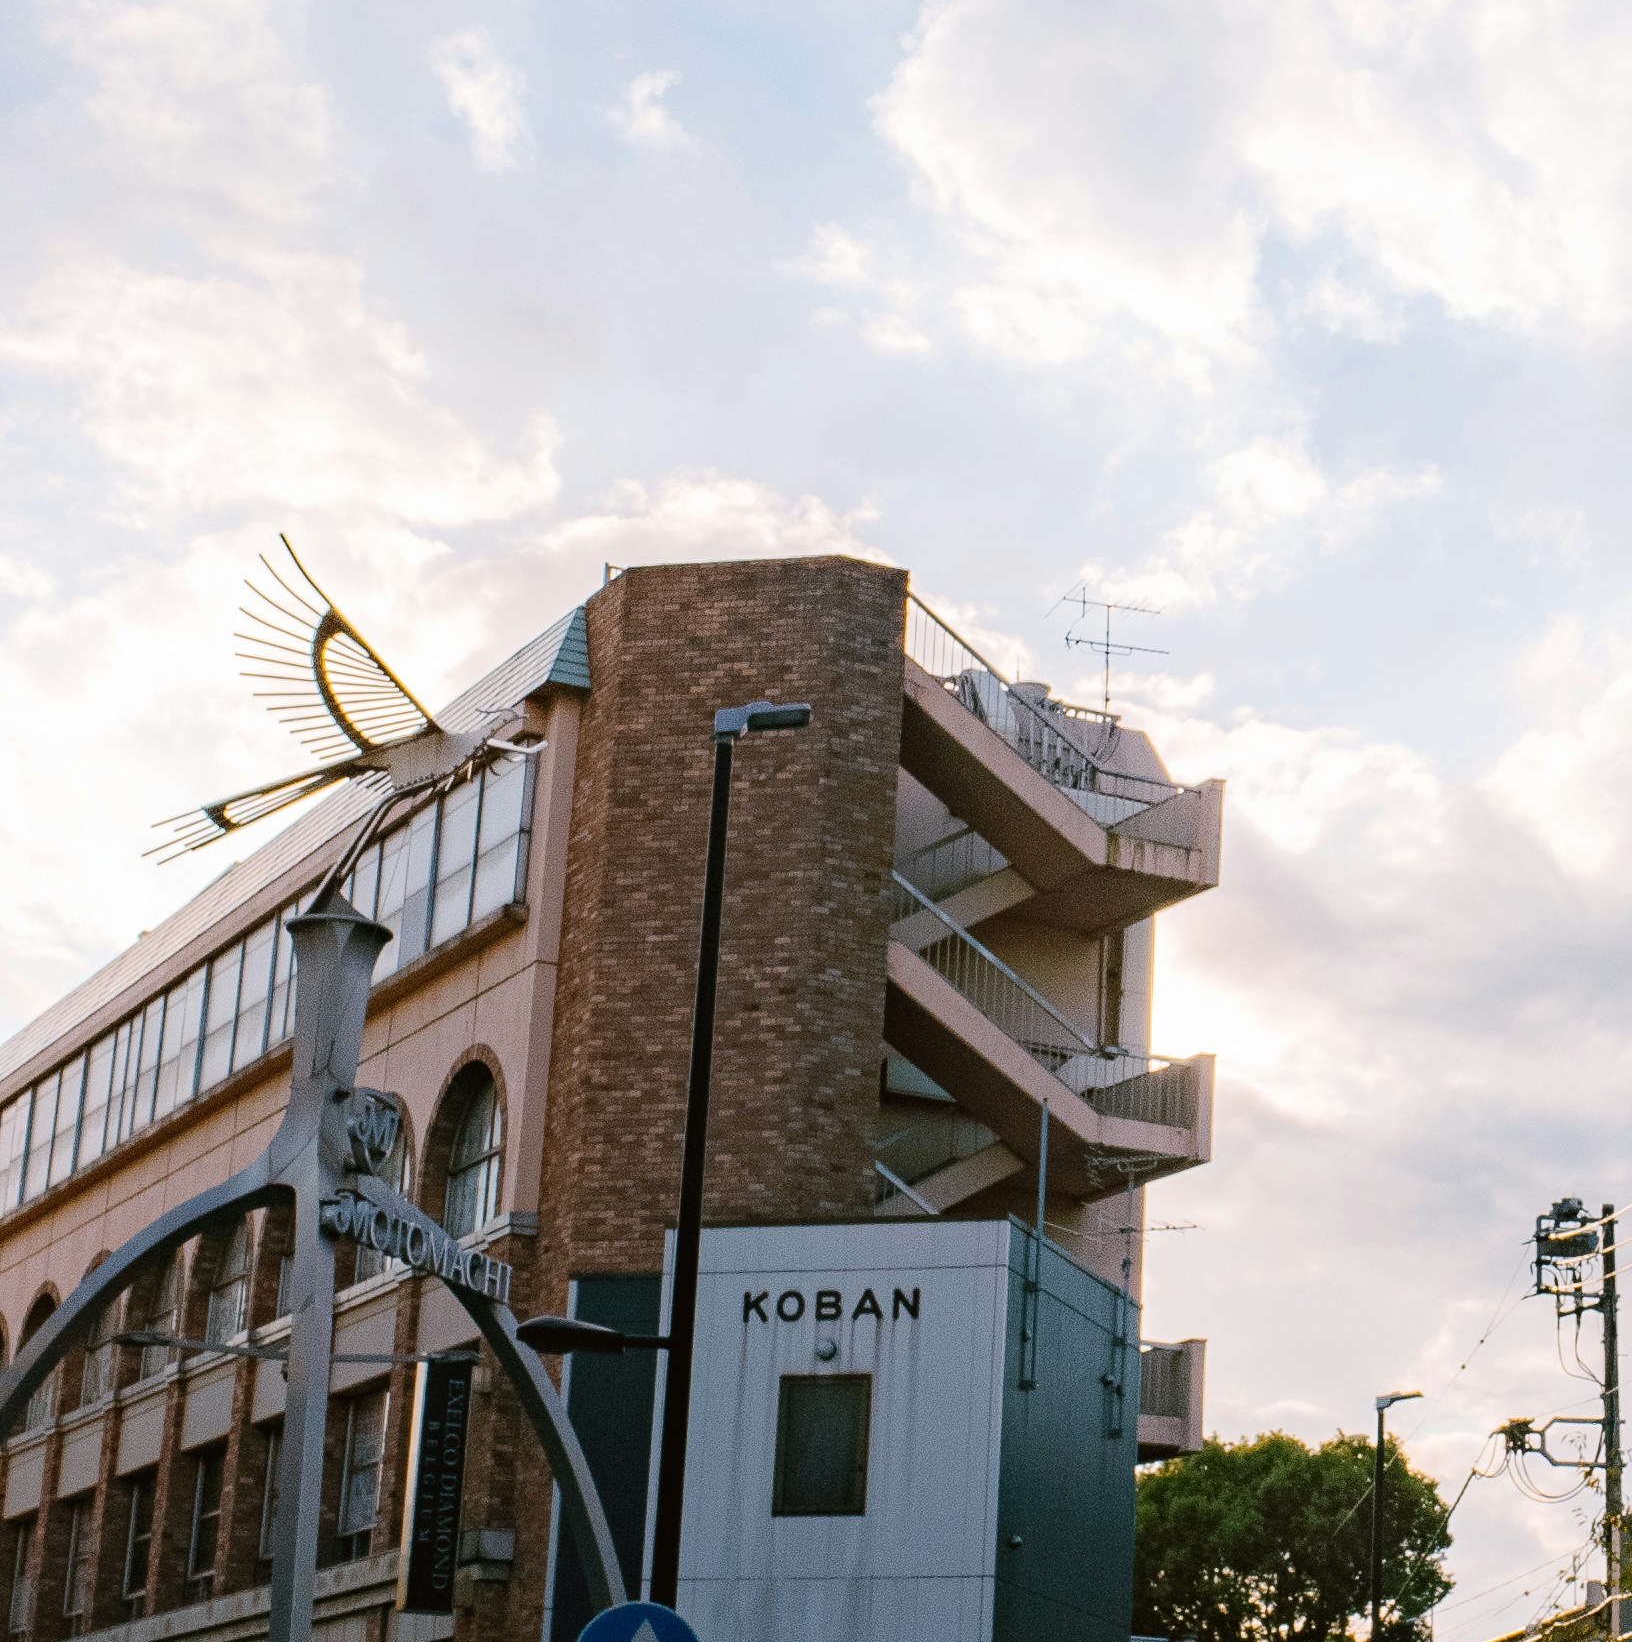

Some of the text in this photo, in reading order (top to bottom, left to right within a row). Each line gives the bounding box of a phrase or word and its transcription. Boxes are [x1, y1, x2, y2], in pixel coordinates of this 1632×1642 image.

[332, 1191, 513, 1304] MOTOMACHI
[743, 1287, 921, 1323] KOBAN
[418, 1420, 441, 1544] BELGIUM
[431, 1378, 466, 1591] EXELCO DIAMOND
